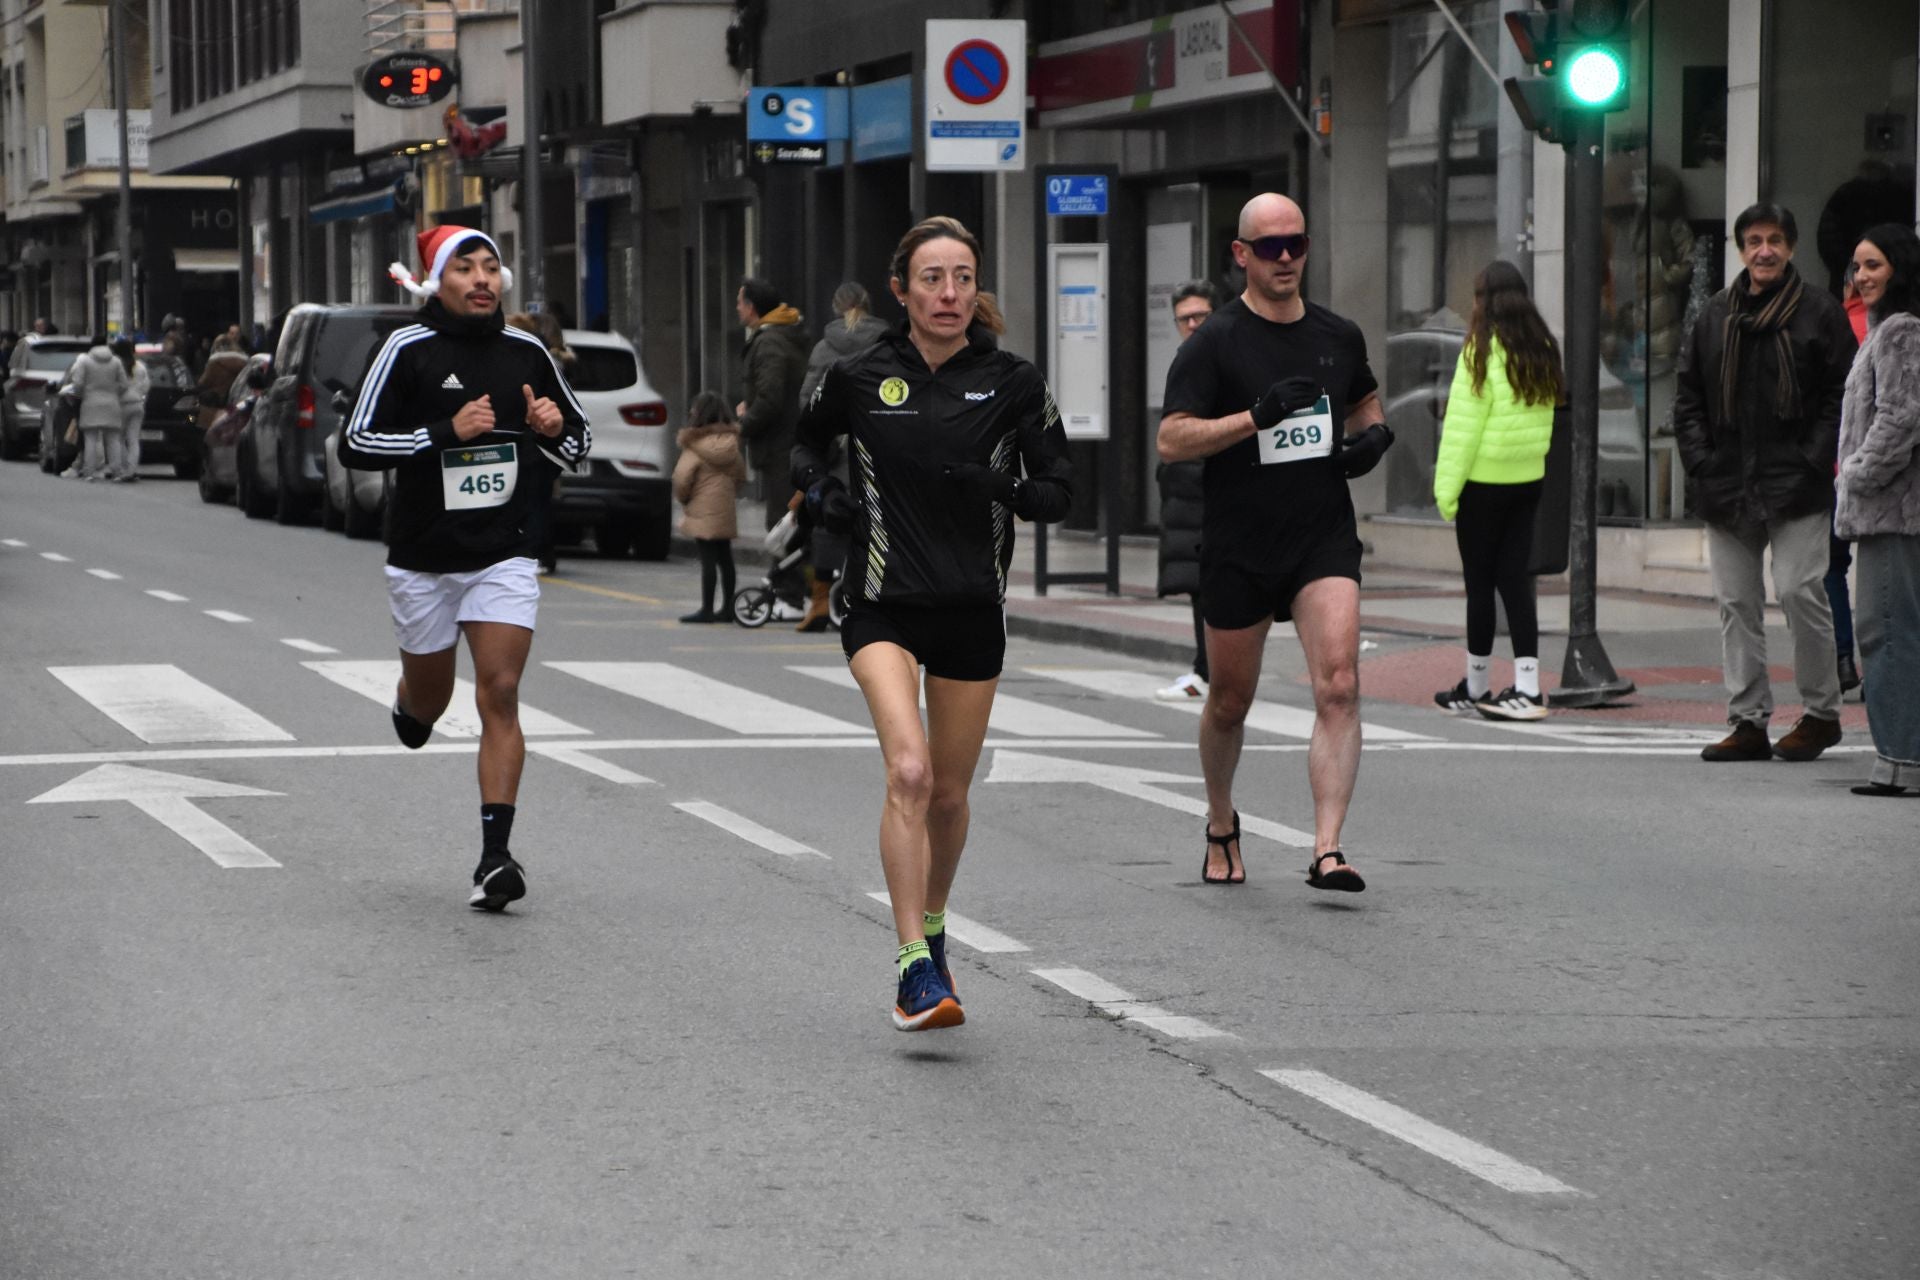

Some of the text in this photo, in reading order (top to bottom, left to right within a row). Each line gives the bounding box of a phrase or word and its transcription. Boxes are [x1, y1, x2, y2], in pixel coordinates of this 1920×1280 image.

[767, 98, 814, 135] B S
[776, 147, 823, 160] ServiRed
[1049, 178, 1071, 195] 07
[1273, 425, 1321, 450] 269
[459, 473, 505, 494] 465
